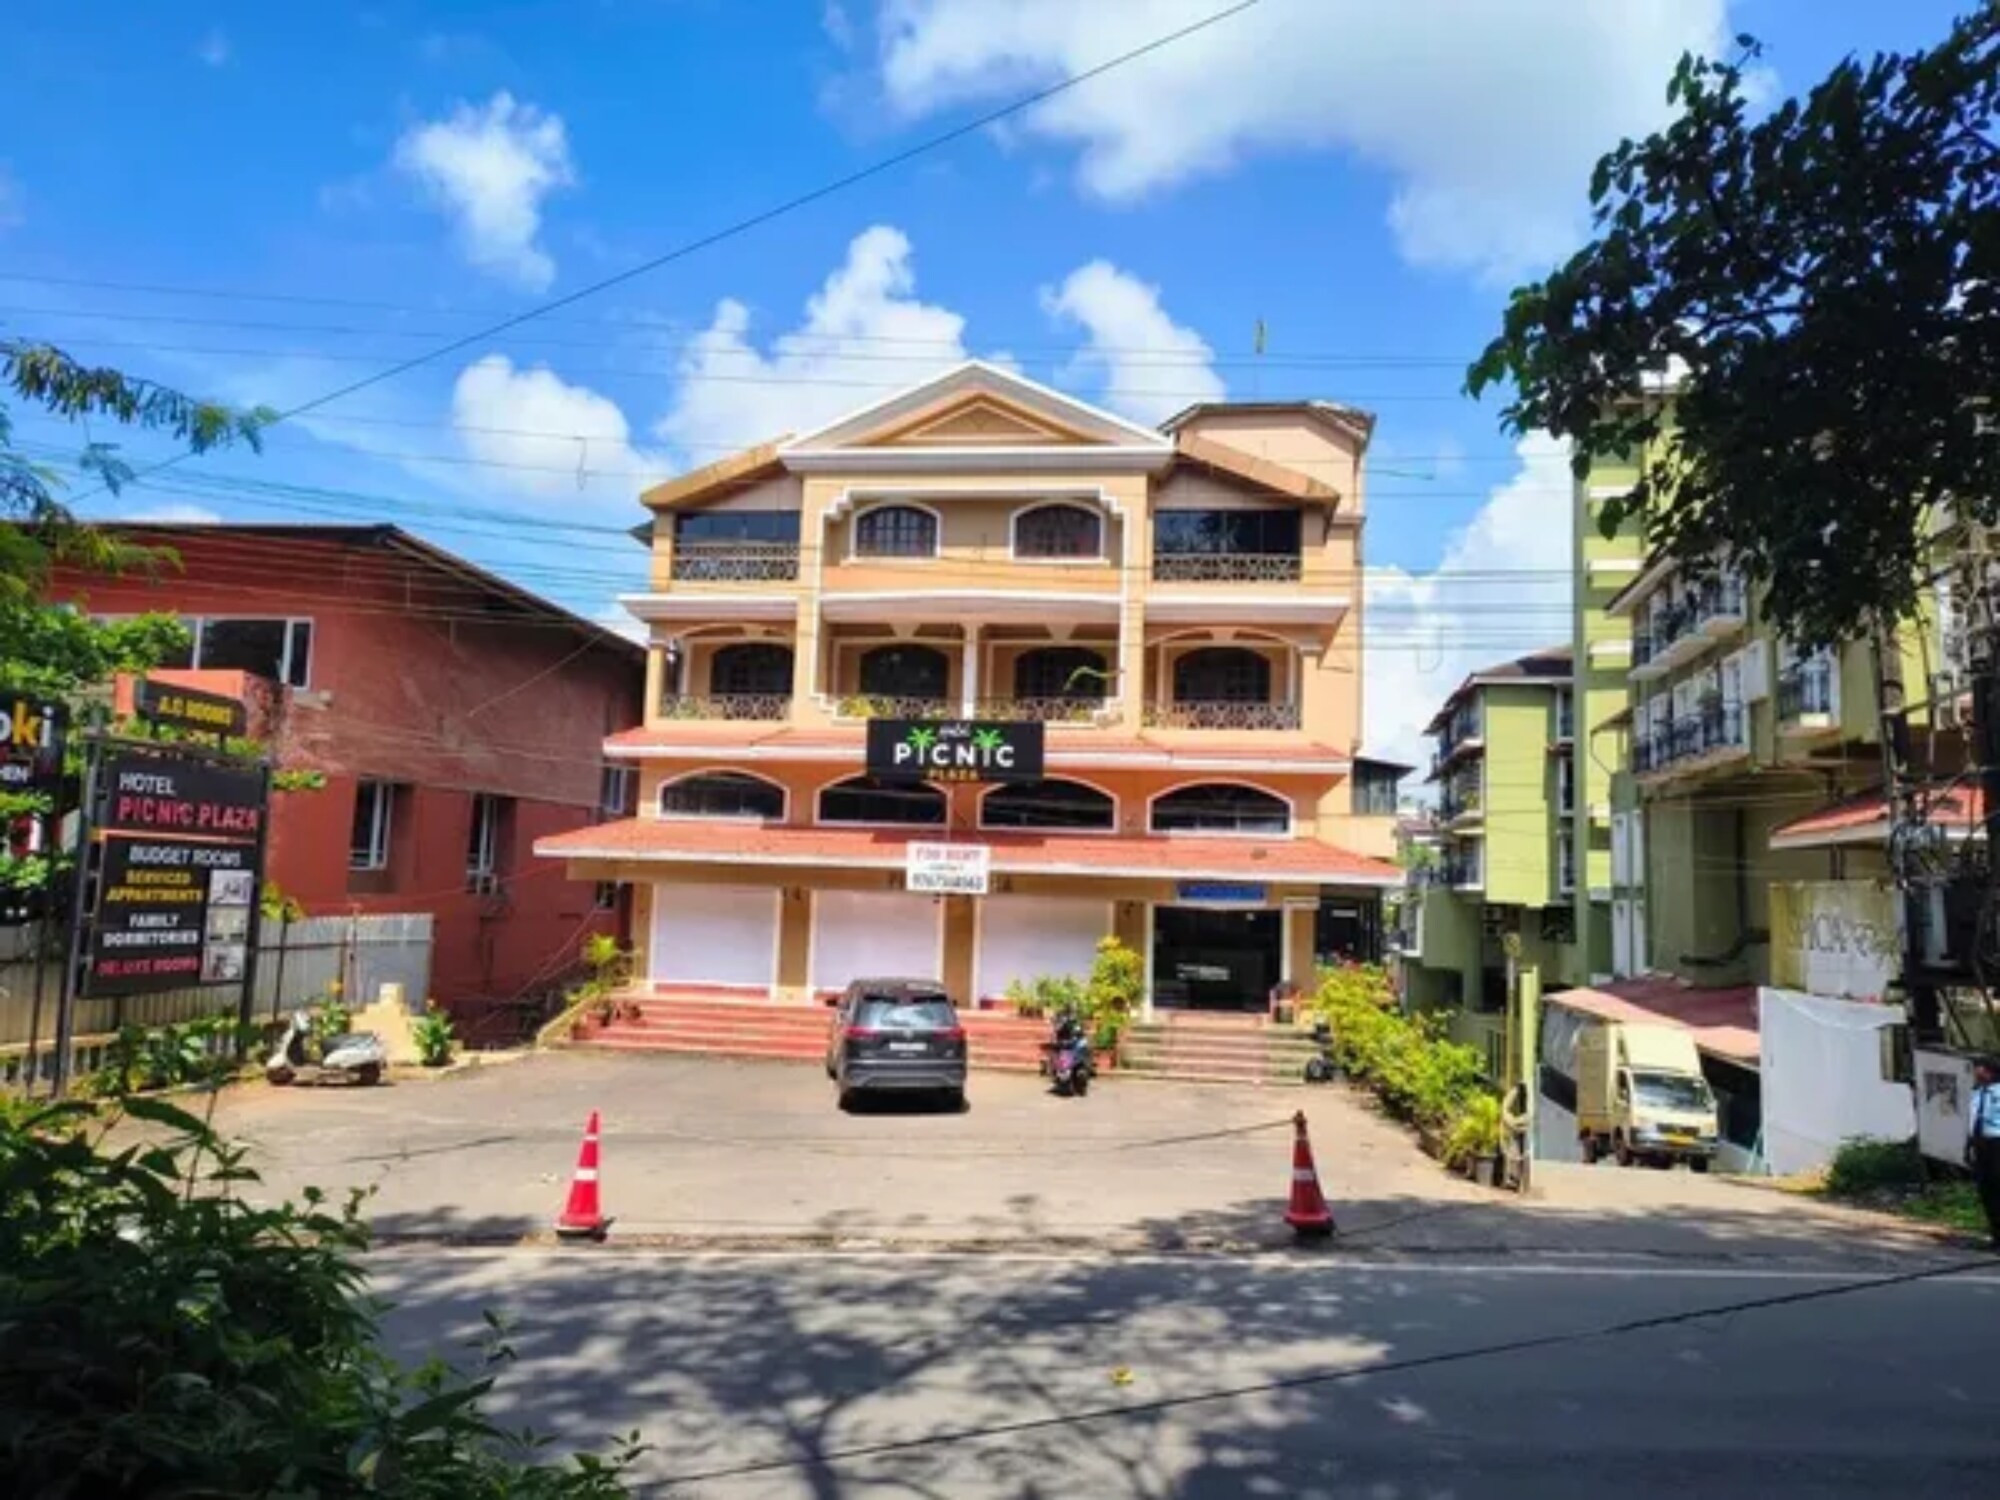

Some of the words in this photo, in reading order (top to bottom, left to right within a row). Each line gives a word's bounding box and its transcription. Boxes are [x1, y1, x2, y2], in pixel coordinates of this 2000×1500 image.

[893, 739, 1014, 768] PICNIC
[119, 772, 175, 795] HOTEL
[119, 797, 194, 825] PICNIC
[199, 805, 258, 830] PLAZA
[129, 846, 191, 864] BUDGET
[129, 912, 180, 928] FAMILY
